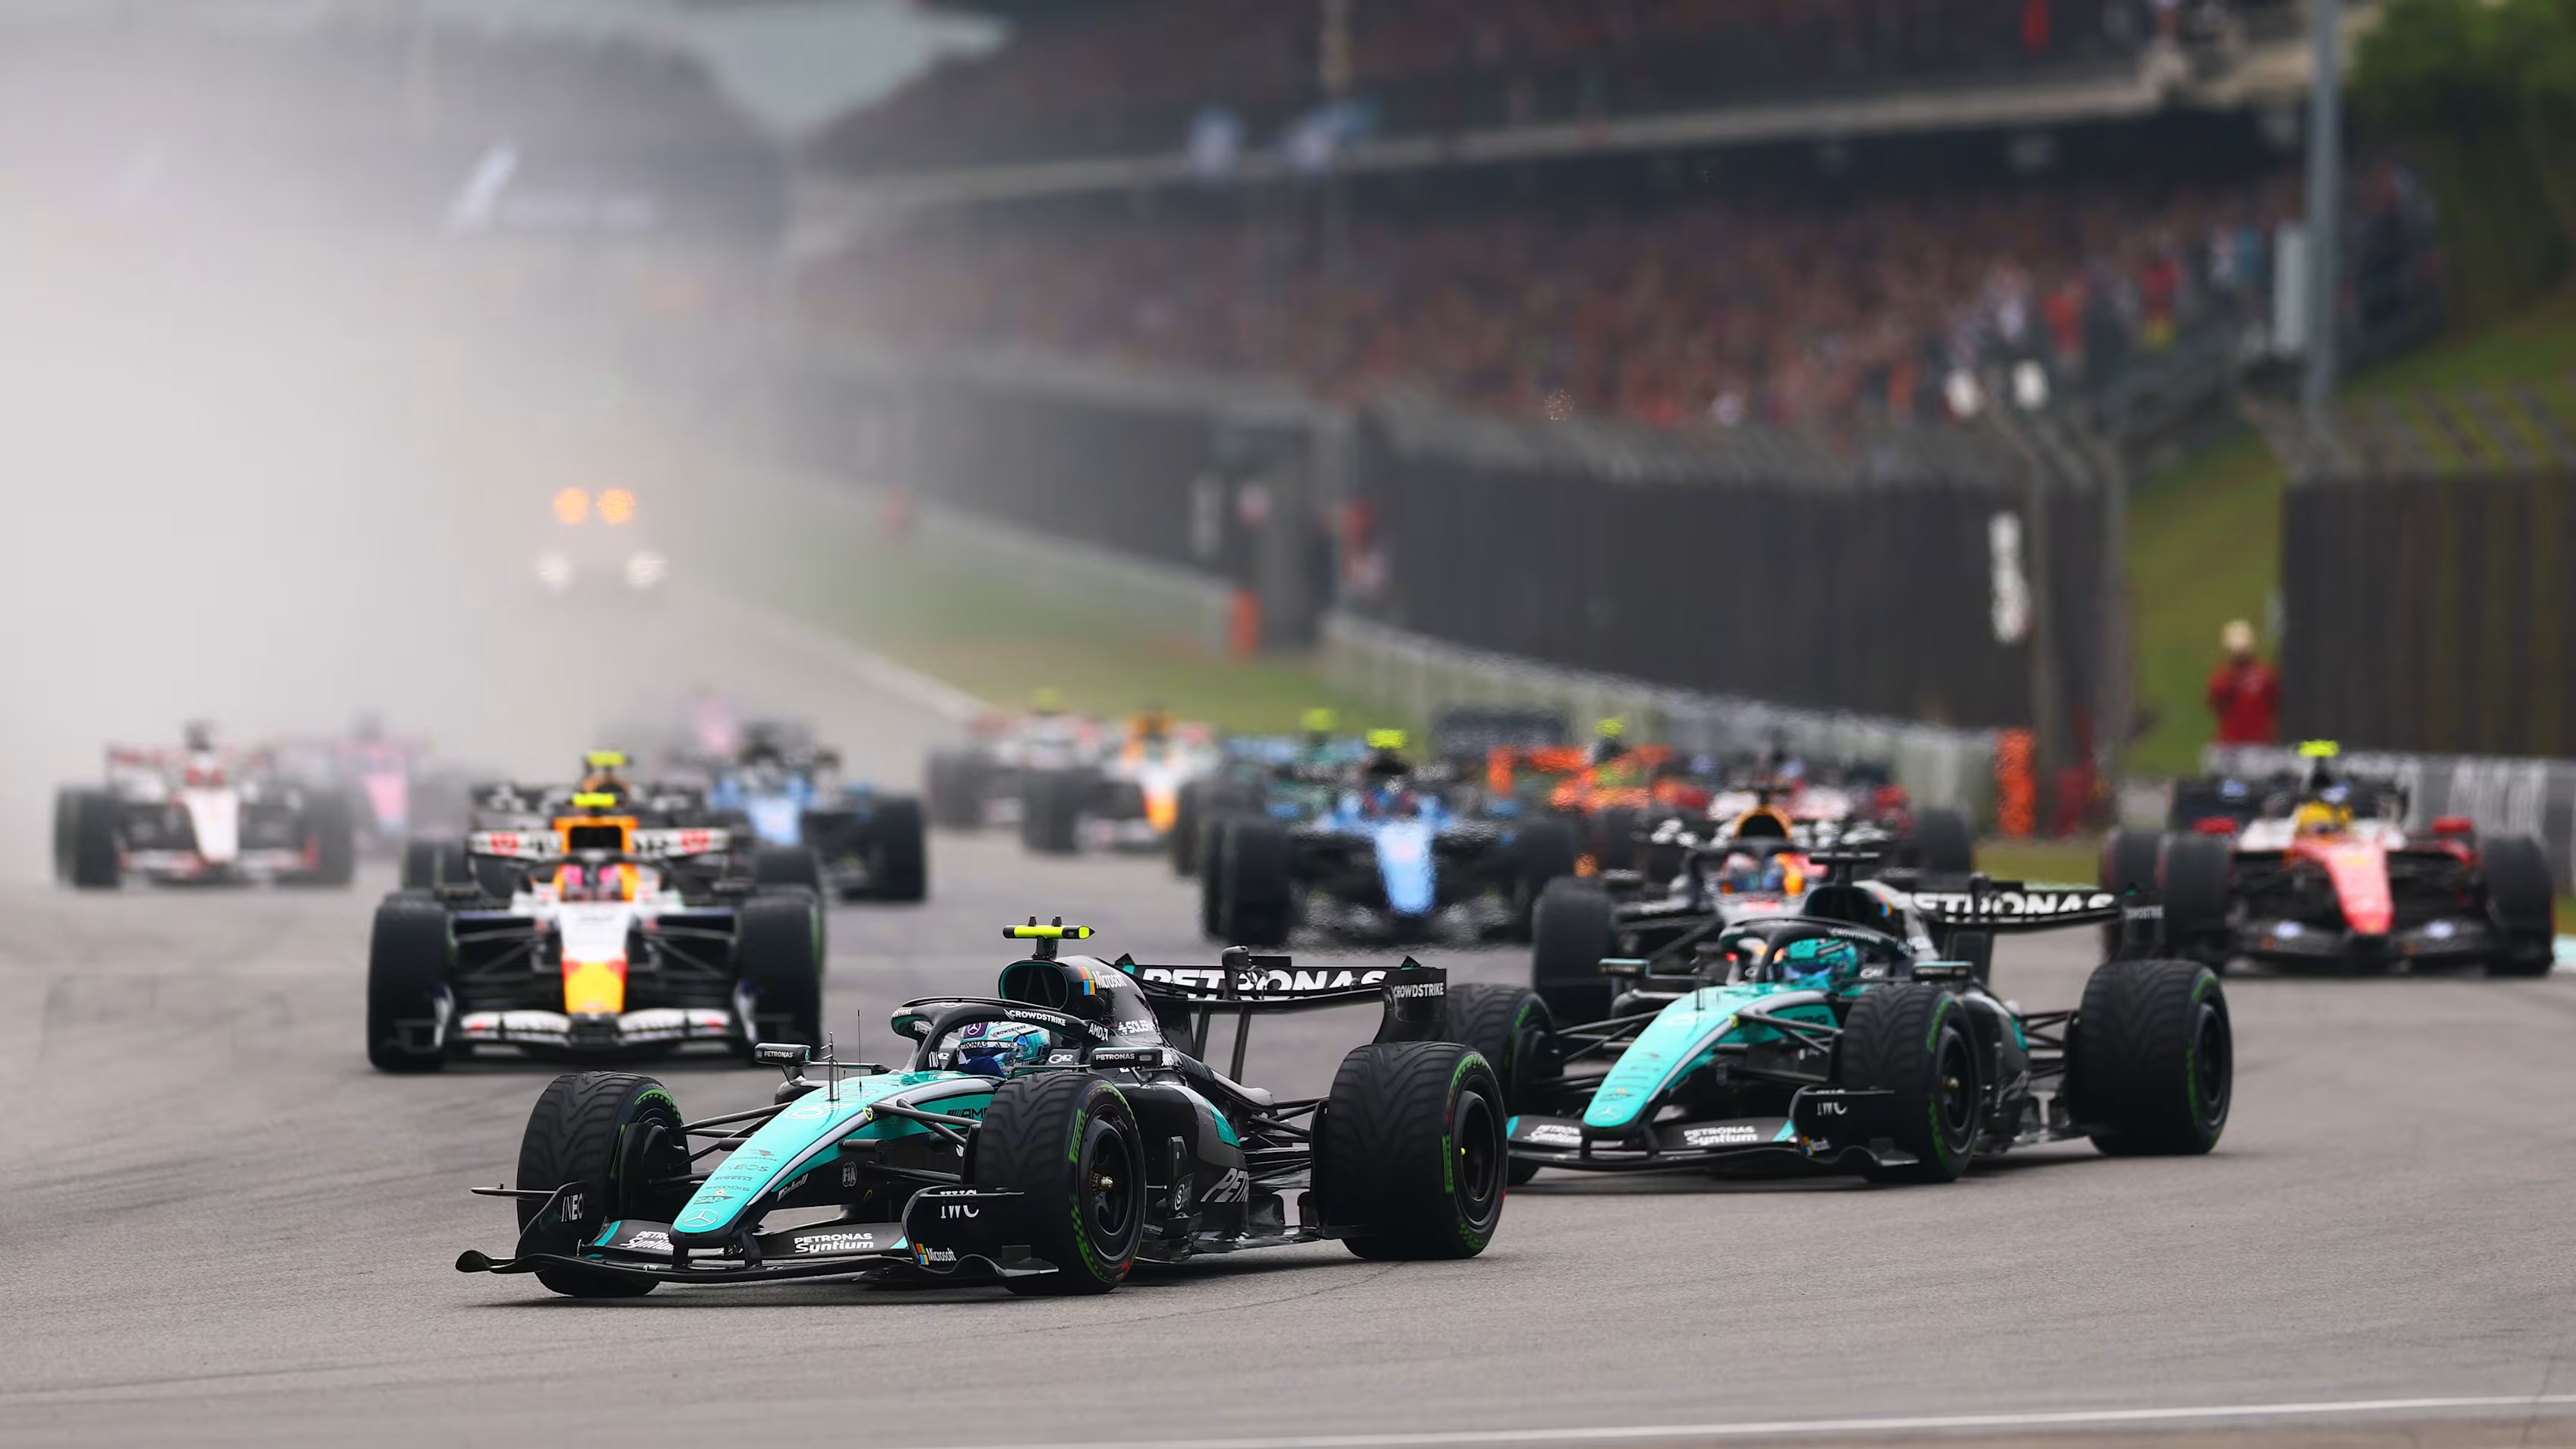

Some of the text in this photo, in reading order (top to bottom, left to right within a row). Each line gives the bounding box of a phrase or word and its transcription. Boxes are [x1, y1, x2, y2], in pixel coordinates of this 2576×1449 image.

[1092, 971, 1128, 989] Microsoft
[1393, 982, 1445, 999] CROWDSTRIKE
[1009, 1009, 1066, 1026] CROWDSTRIKE
[764, 1050, 794, 1059] PETRONAS
[1048, 1054, 1074, 1064] G42
[1095, 1053, 1135, 1061] PETRONAS
[961, 1107, 987, 1119] AM
[560, 1191, 584, 1222] INEO
[794, 1233, 873, 1244] PETRONAS
[794, 1240, 874, 1253] Syntium
[928, 1248, 957, 1261] Microsoft
